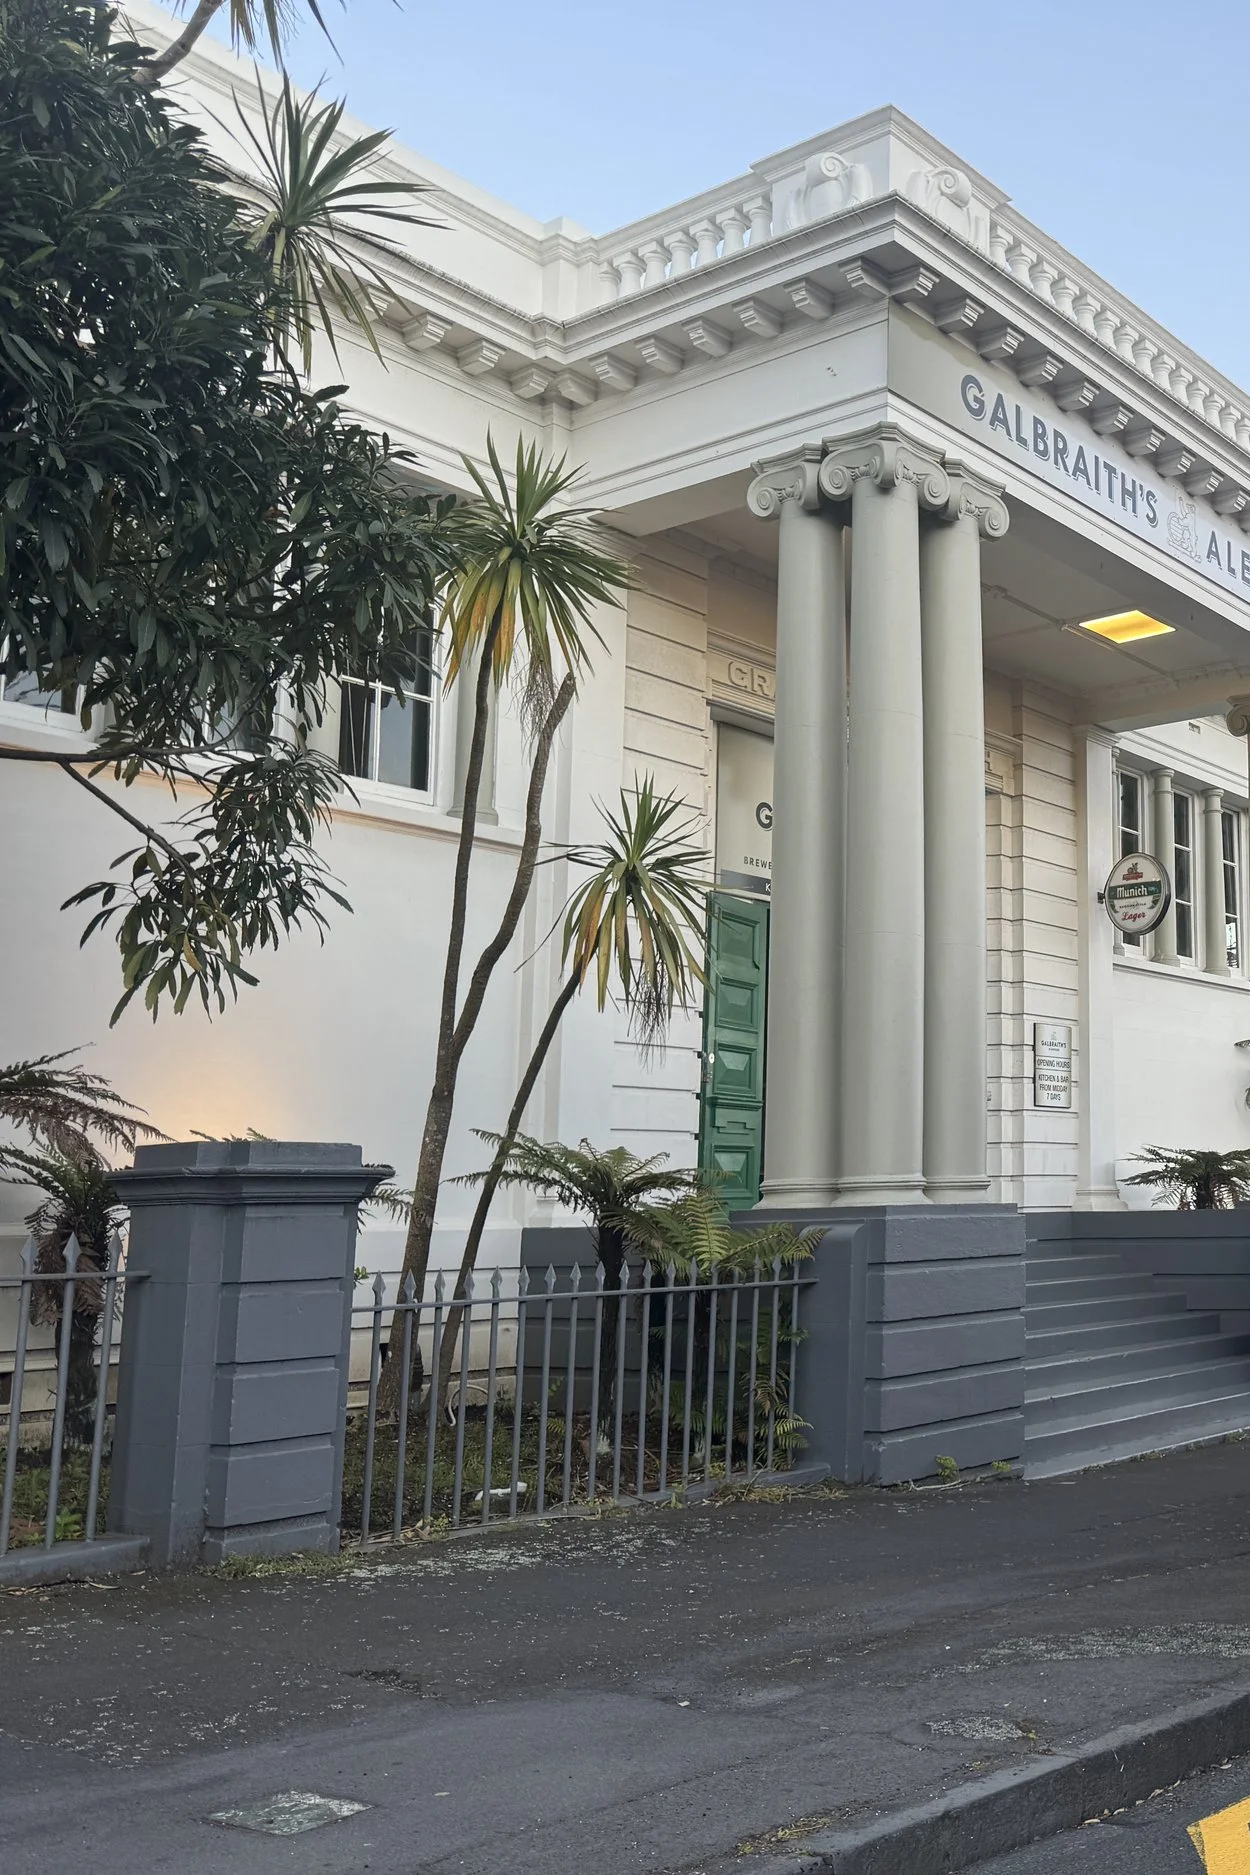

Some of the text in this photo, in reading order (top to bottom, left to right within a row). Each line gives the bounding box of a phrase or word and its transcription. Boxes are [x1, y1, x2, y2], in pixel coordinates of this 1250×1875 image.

[960, 374, 1159, 528] GALBRAITH'S
[1116, 885, 1148, 898] Munich
[1121, 911, 1146, 922] Lager
[1037, 1059, 1071, 1069] OPENING HOURS
[1038, 1074, 1056, 1082] KITCHEN
[1039, 1083, 1051, 1091] FROM
[1050, 1093, 1061, 1101] DAYS
